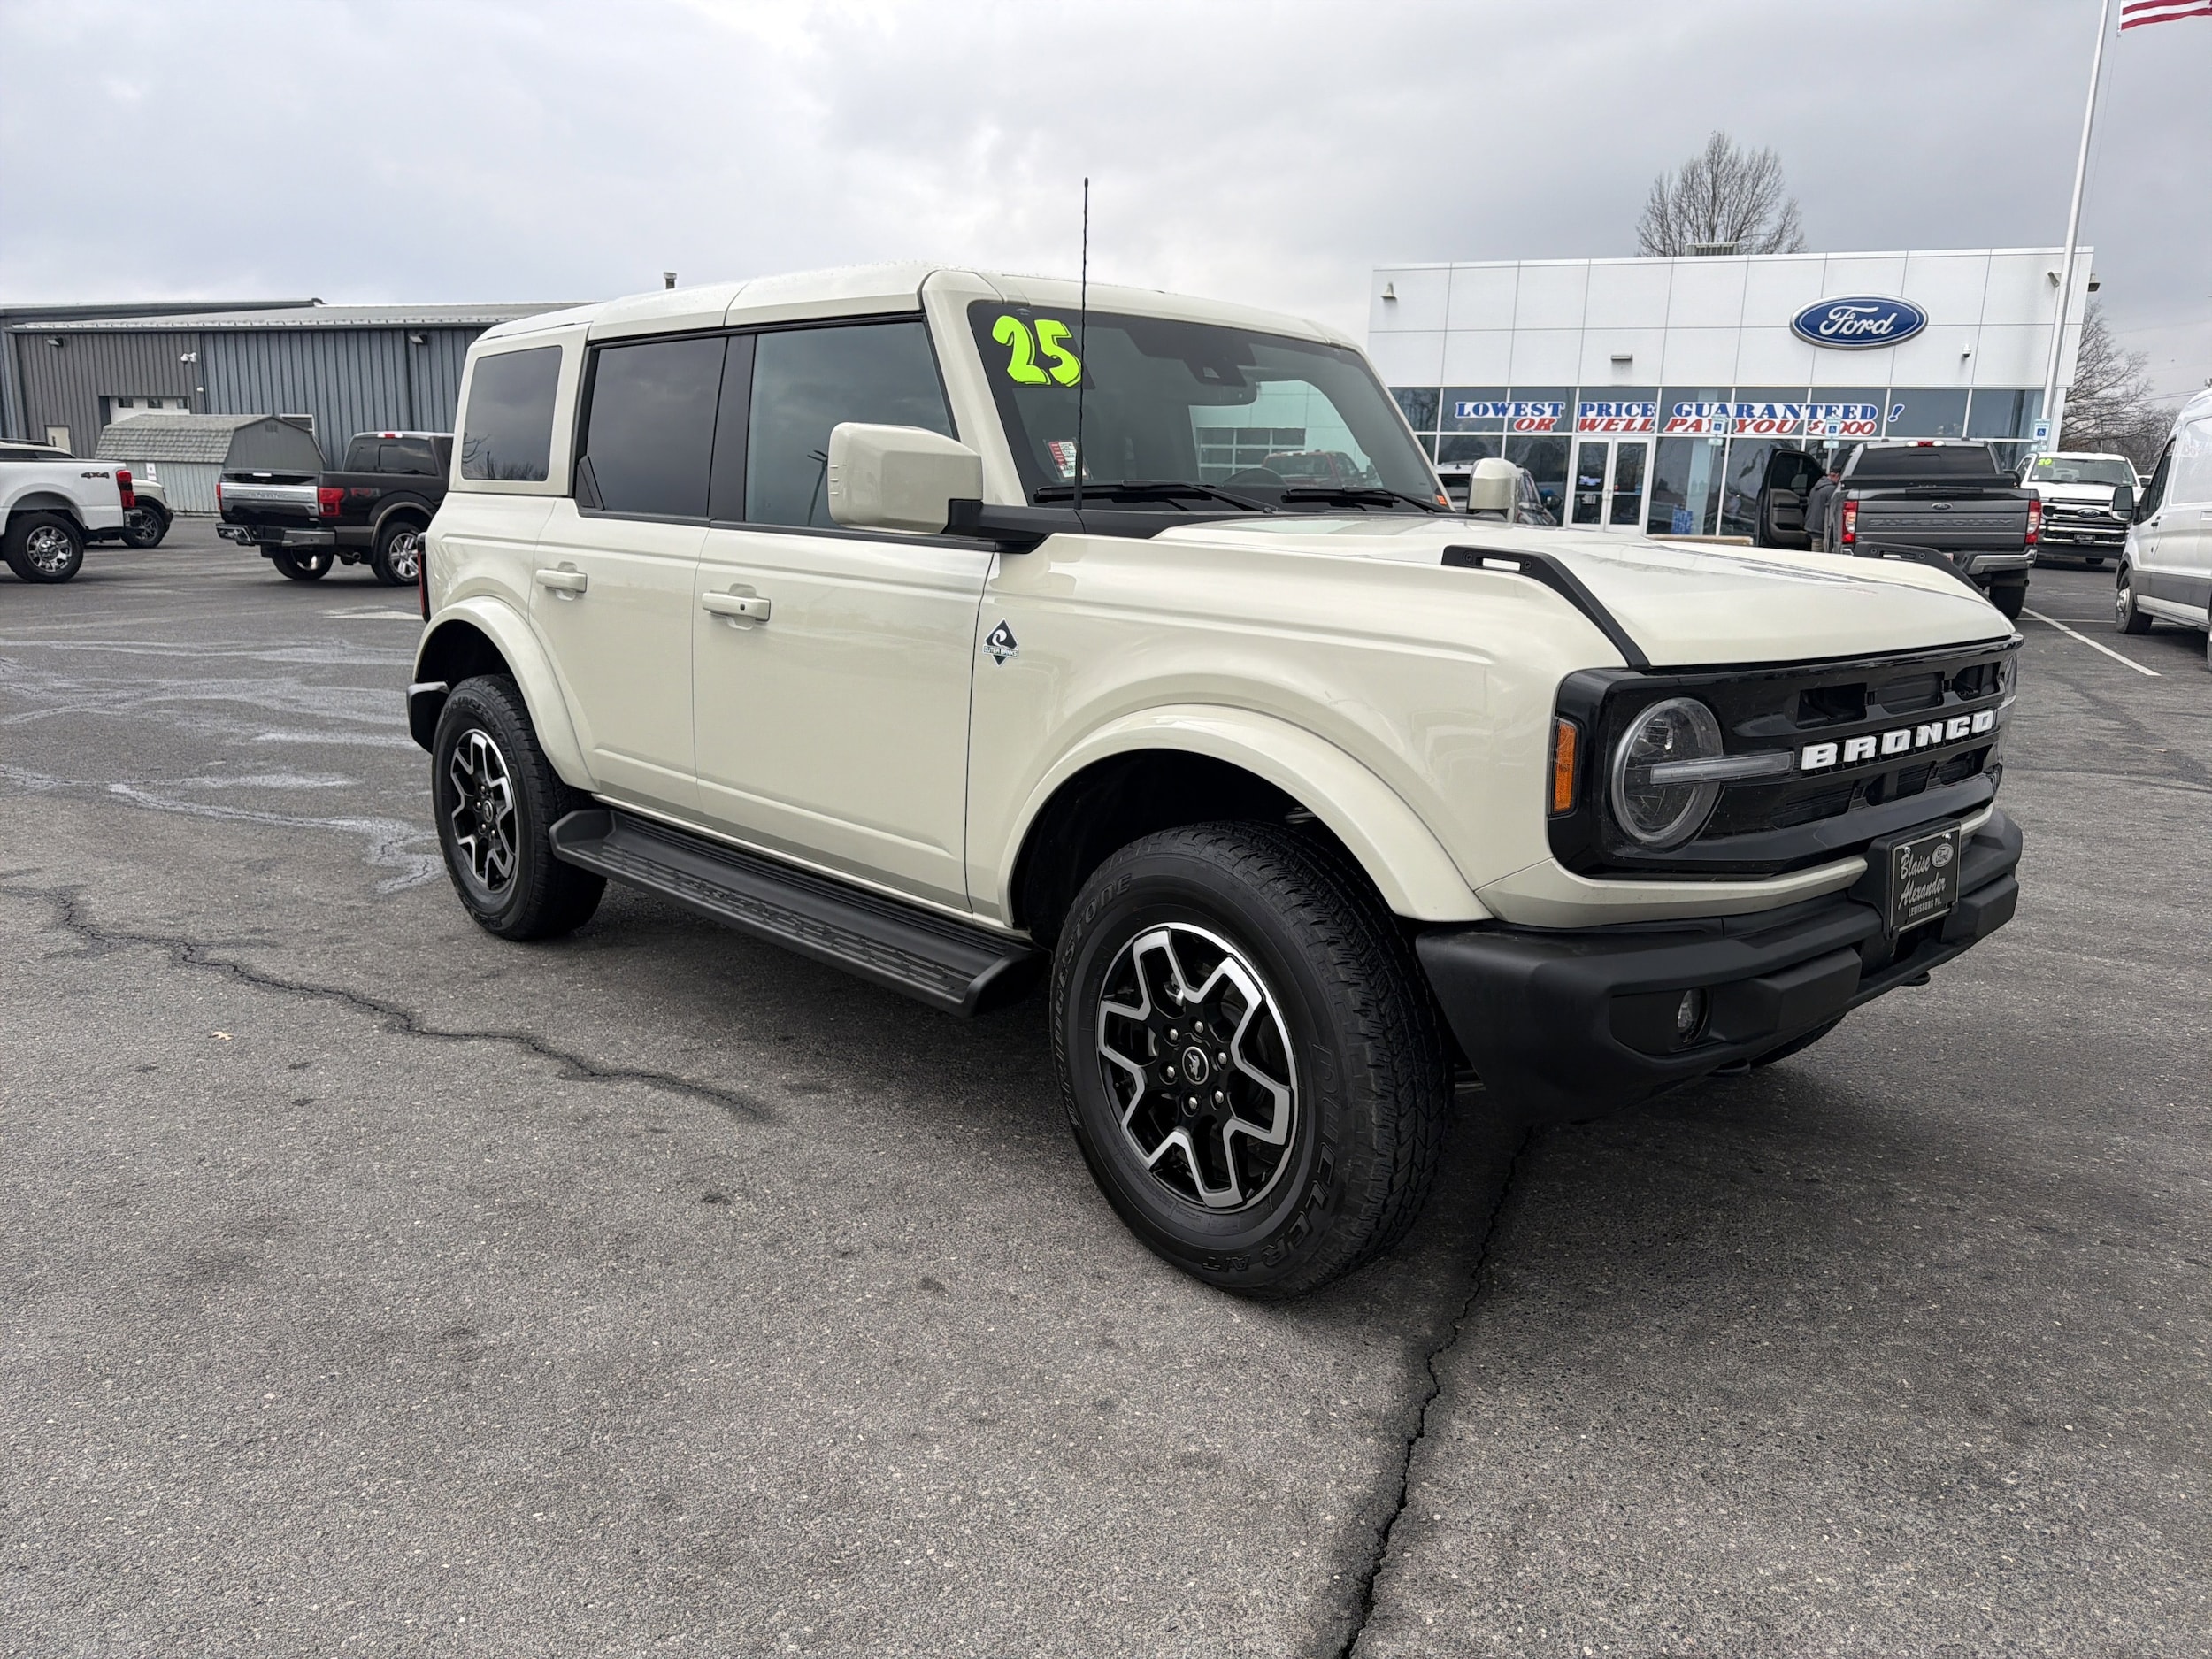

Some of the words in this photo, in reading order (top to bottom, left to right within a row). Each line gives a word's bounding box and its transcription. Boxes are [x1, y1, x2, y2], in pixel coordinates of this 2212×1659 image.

[1819, 306, 1897, 335] Ford
[992, 315, 1082, 387] 25
[1456, 403, 1564, 418] LOWEST
[1579, 403, 1656, 418] PRICE
[1674, 403, 1878, 419] GUARANTEED
[1515, 418, 1555, 431] OR
[1734, 419, 1800, 434] YOU
[1801, 710, 1993, 771] BRONCO
[1900, 853, 1931, 879] Blaise
[1898, 872, 1947, 910] Alexander
